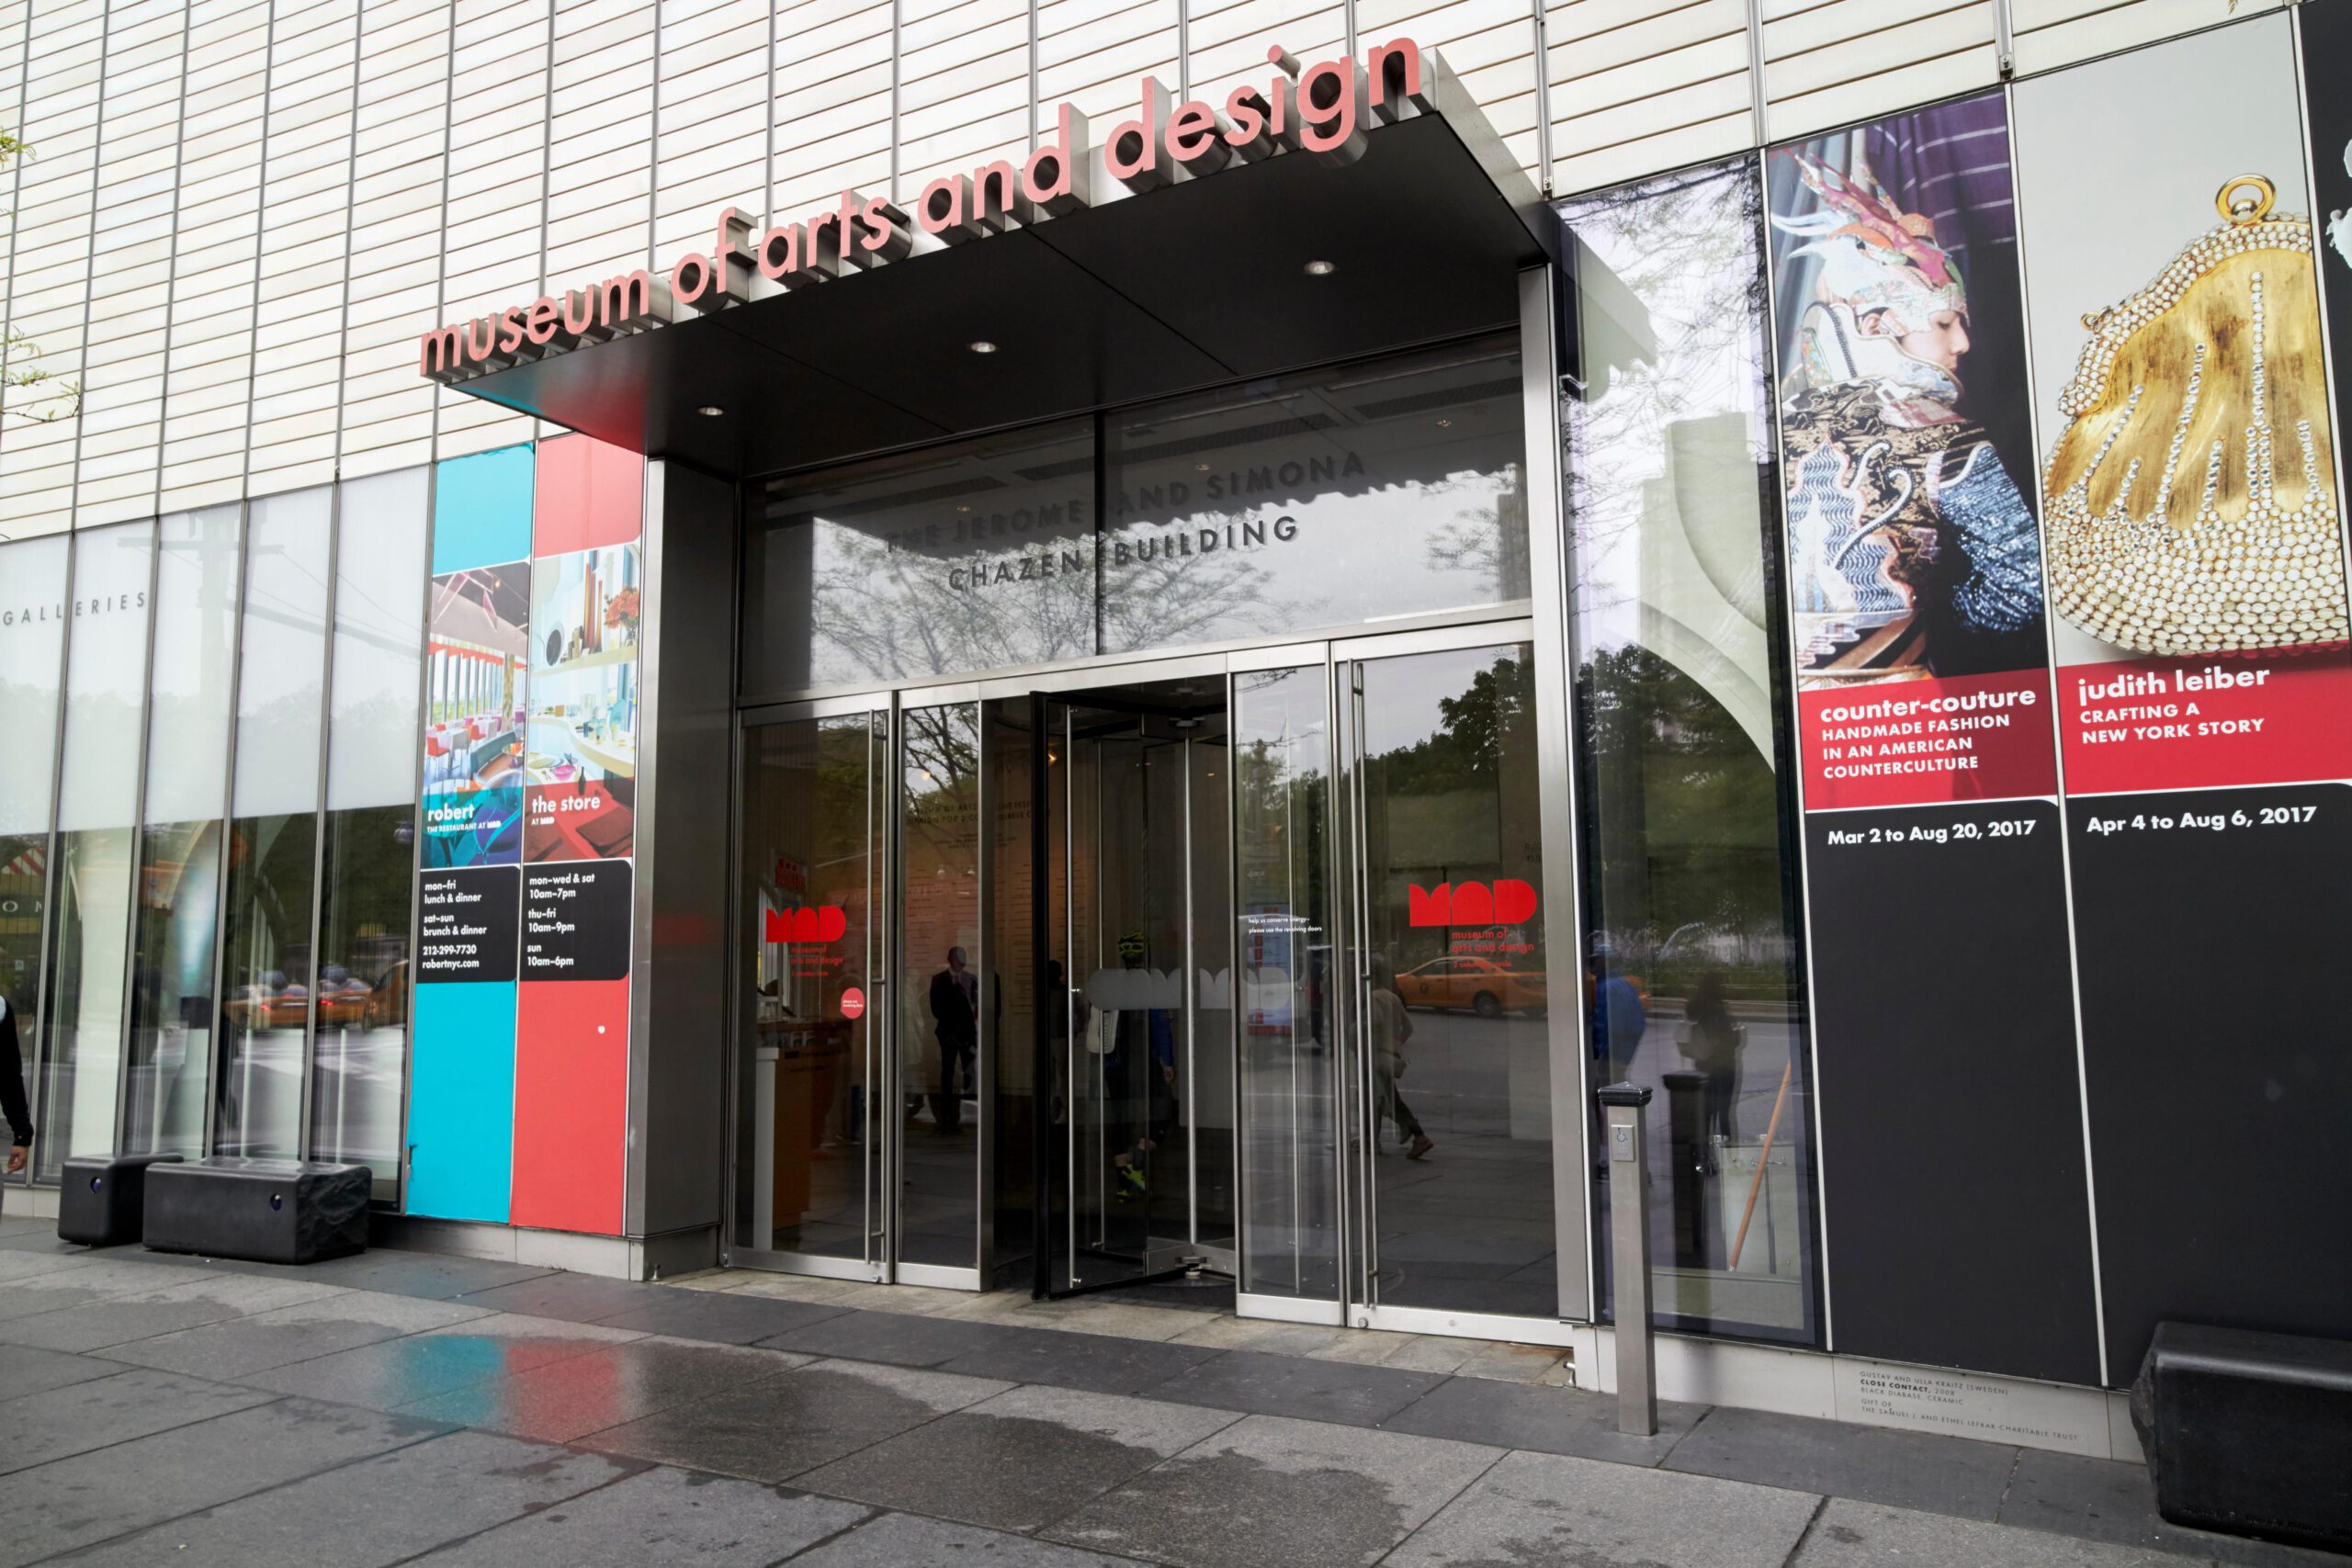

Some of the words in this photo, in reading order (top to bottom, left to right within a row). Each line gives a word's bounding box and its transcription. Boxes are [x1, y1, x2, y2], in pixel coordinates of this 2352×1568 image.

[420, 269, 650, 378] museum
[671, 207, 741, 305] of
[758, 189, 892, 278] arts
[917, 102, 1072, 235] and
[1104, 37, 1421, 179] design
[954, 499, 1084, 543] JEROME
[1116, 481, 1190, 516] AND
[1206, 451, 1365, 500] SIMONA
[948, 549, 1082, 591] CHAZEN
[1114, 515, 1298, 566] BUILDING
[3, 592, 145, 626] GALLERIES
[2078, 670, 2166, 706] judith
[2175, 666, 2270, 693] leiber
[1820, 690, 2036, 722] counter-couture
[2079, 703, 2178, 725] CRAFTING
[2185, 702, 2200, 716] A
[1822, 721, 1922, 741] HANDMADE
[1928, 714, 2009, 733] FASHION
[2082, 728, 2128, 744] NEW
[2133, 724, 2191, 741] YORK
[2198, 717, 2265, 736] STORY
[1823, 747, 1841, 760] IN
[1848, 744, 1872, 758] AN
[1879, 737, 1973, 756] AMERICAN
[1824, 756, 1978, 779] COUNTERCULTURE
[428, 803, 475, 822] robert
[532, 795, 557, 814] the
[560, 795, 601, 812] store
[438, 822, 477, 832] RESTAURANT
[531, 818, 539, 826] AT
[1827, 830, 1865, 845] Mar
[1869, 828, 1882, 842] 2
[1884, 828, 1905, 842] to
[1908, 826, 1948, 843] Aug
[1951, 823, 1984, 840] 20,
[1987, 819, 2037, 837] 2017
[2086, 817, 2127, 836] Apr
[2131, 815, 2145, 829] 4
[2150, 815, 2174, 829] to
[2179, 812, 2225, 831] Aug
[2231, 809, 2253, 828] 6,
[2258, 806, 2317, 825] 2017
[572, 874, 580, 884] &
[582, 874, 595, 883] sat
[424, 894, 446, 905] lunch
[447, 894, 454, 904] &
[455, 893, 481, 903] dinner
[1408, 879, 1538, 927] MAD
[424, 926, 451, 937] brunch
[452, 926, 459, 936] &
[460, 925, 487, 935] dinner
[766, 906, 847, 942] MAD
[1452, 931, 1495, 940] museum
[423, 944, 477, 956] 212-299-7730
[527, 943, 542, 953] sun
[1452, 943, 1472, 953] arts
[1475, 941, 1496, 952] and
[1498, 941, 1534, 954] design
[423, 960, 480, 970] robertnyc.com
[1860, 1371, 1891, 1380] GUSTAV
[1936, 1381, 1963, 1390] KRAITZ
[1860, 1379, 1885, 1387] CLOSE
[1889, 1382, 1931, 1393] CONTACT,
[1935, 1388, 1955, 1396] 2008
[1860, 1387, 1884, 1395] BLACK
[1927, 1395, 1963, 1405] CERAMIC
[1879, 1408, 1909, 1417] SAMUEL
[1941, 1416, 1965, 1426] ETHEL
[1998, 1425, 2049, 1437] CHARITABLE
[2052, 1432, 2078, 1440] TRUST
